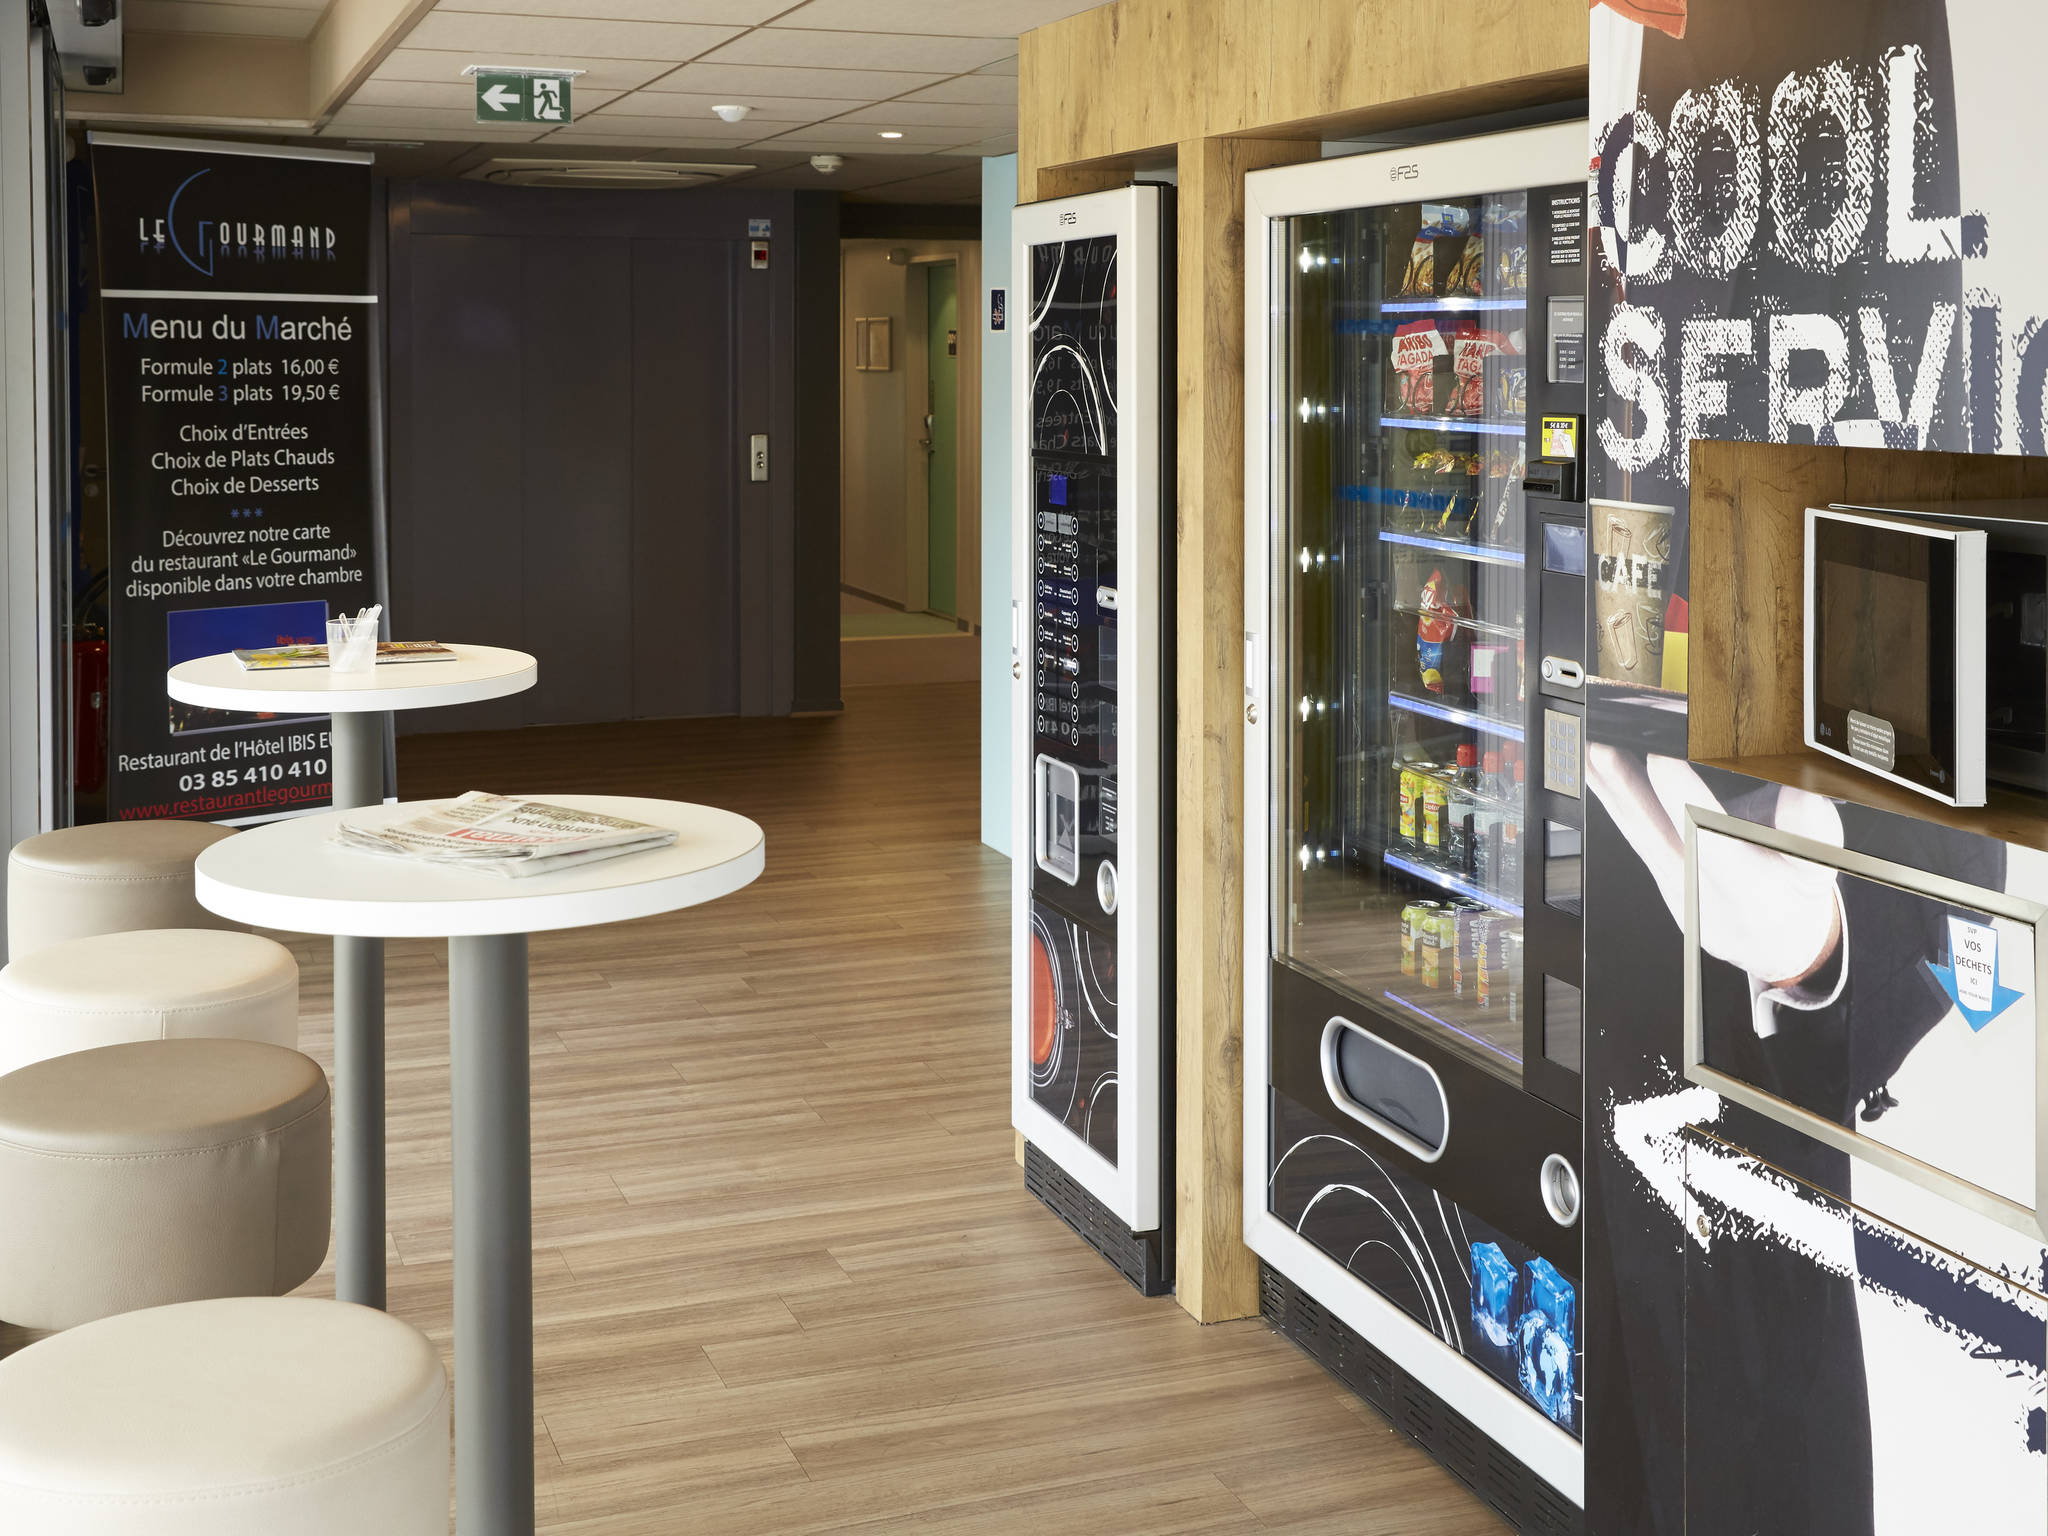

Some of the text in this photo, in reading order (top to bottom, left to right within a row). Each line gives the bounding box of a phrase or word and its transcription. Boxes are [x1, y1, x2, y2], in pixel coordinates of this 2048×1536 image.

[1596, 44, 1990, 284] COOL
[139, 168, 336, 277] LE GOURMAND
[123, 312, 352, 341] Menu du Marché
[141, 358, 339, 379] Formule 2 plats 16,00 €
[142, 384, 340, 405] Formule 3 plats 19,50 €
[179, 423, 309, 442] Choix d'Entrées
[151, 448, 335, 470] Choix de Plats Chauds
[171, 475, 319, 496] Choix de Desserts
[163, 523, 331, 548] Découvrez notre carte
[131, 543, 357, 573] du restaurant «Le Gourmand»
[126, 566, 362, 600] disponible dans votre chambre
[1598, 551, 1662, 600] CAFE
[119, 747, 207, 772] Restaurant
[210, 743, 231, 761] de
[234, 736, 284, 759] l'Hôtel
[288, 733, 316, 752] IBIS
[179, 758, 327, 792] 03 85 410 410
[1964, 939, 1982, 953] VOS
[1955, 955, 1992, 975] DECHETS
